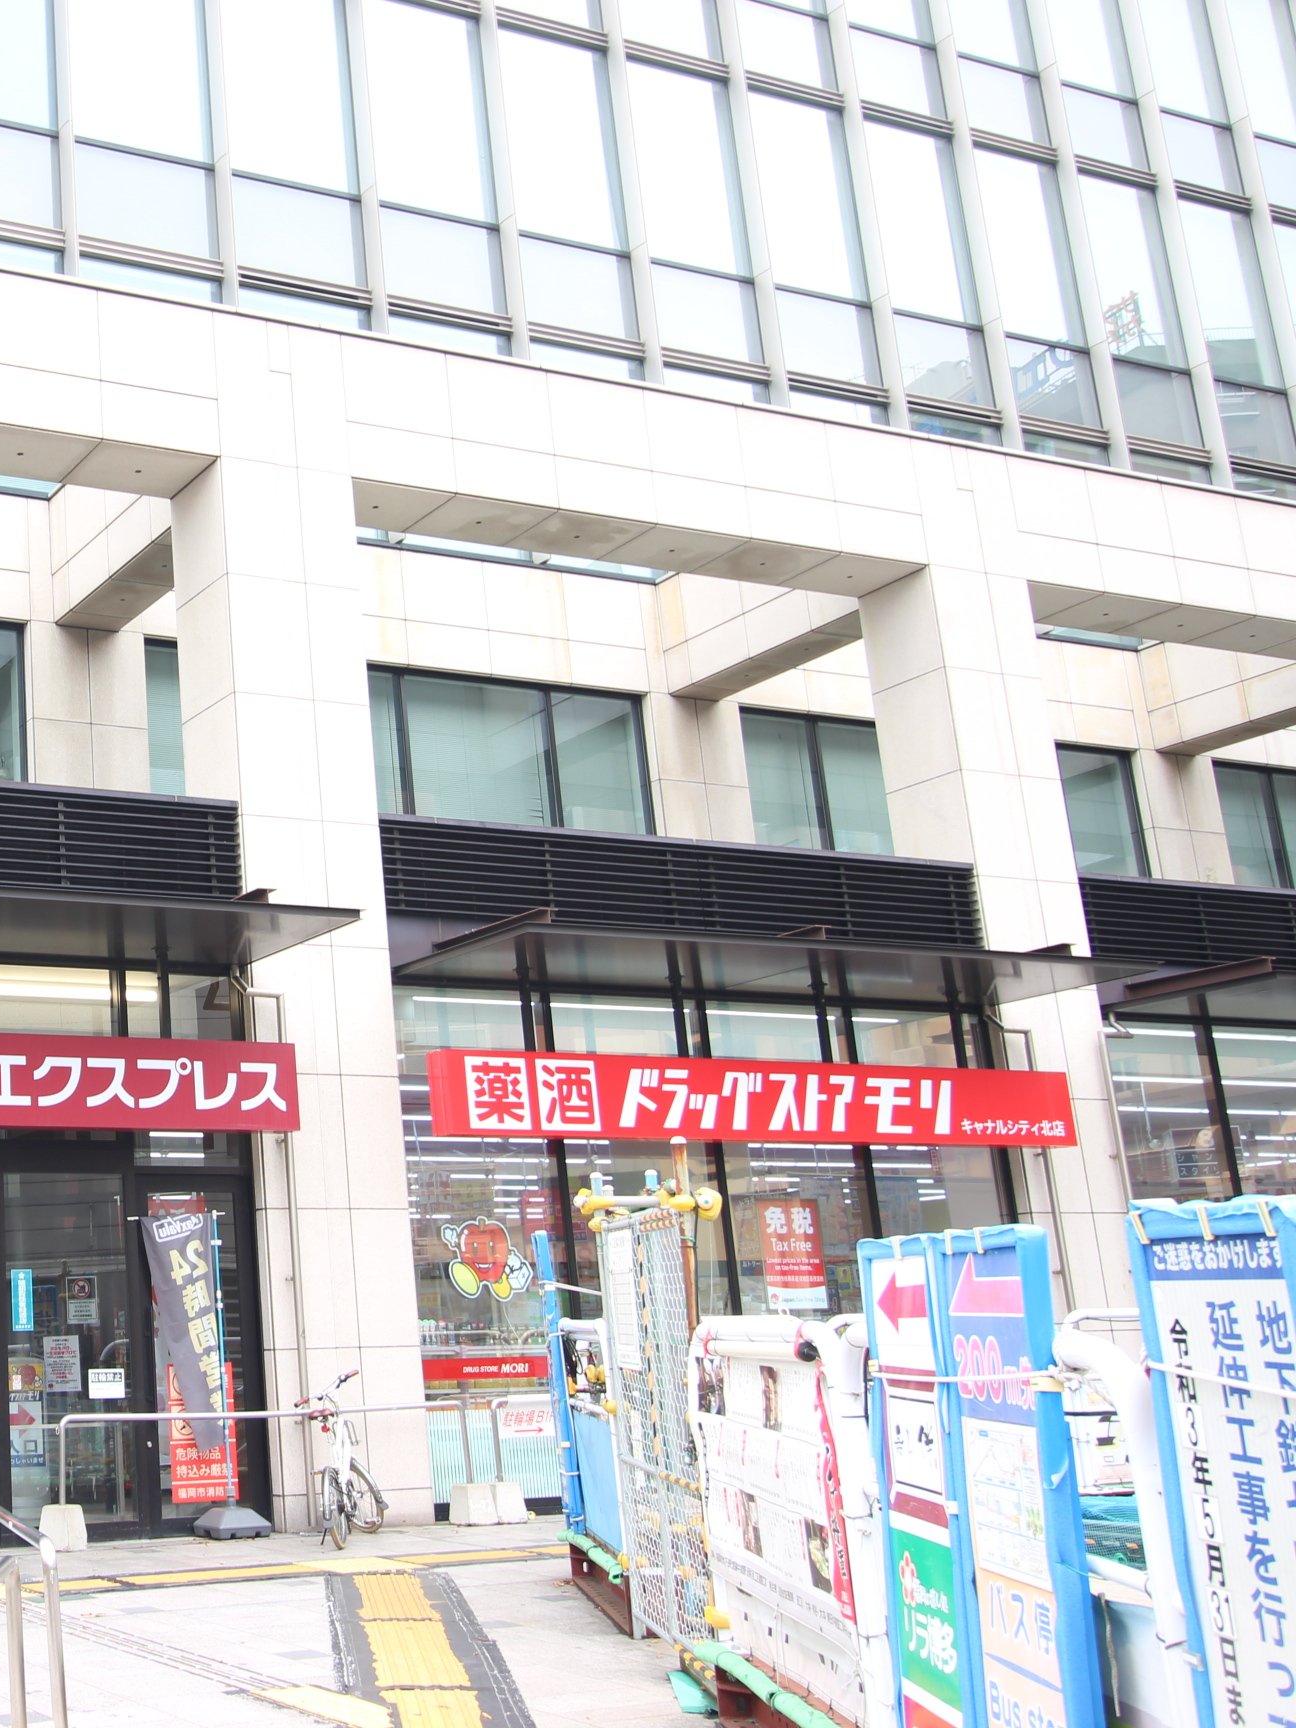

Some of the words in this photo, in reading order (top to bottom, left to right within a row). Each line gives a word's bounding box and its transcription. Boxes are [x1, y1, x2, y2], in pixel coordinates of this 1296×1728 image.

[471, 1061, 525, 1124] 薬
[541, 1064, 596, 1125] 酒
[960, 1118, 1066, 1136] キャナルシティ北店
[765, 1207, 814, 1234] 免税
[770, 1238, 788, 1251] Tax
[790, 1238, 812, 1251] Free
[501, 1363, 529, 1374] MORI
[175, 1446, 221, 1461] 危険物品
[178, 1486, 235, 1499] 福岡市消防
[990, 1581, 1053, 1656] バス停
[989, 1679, 1022, 1728] Bus
[1027, 1706, 1066, 1728] st
